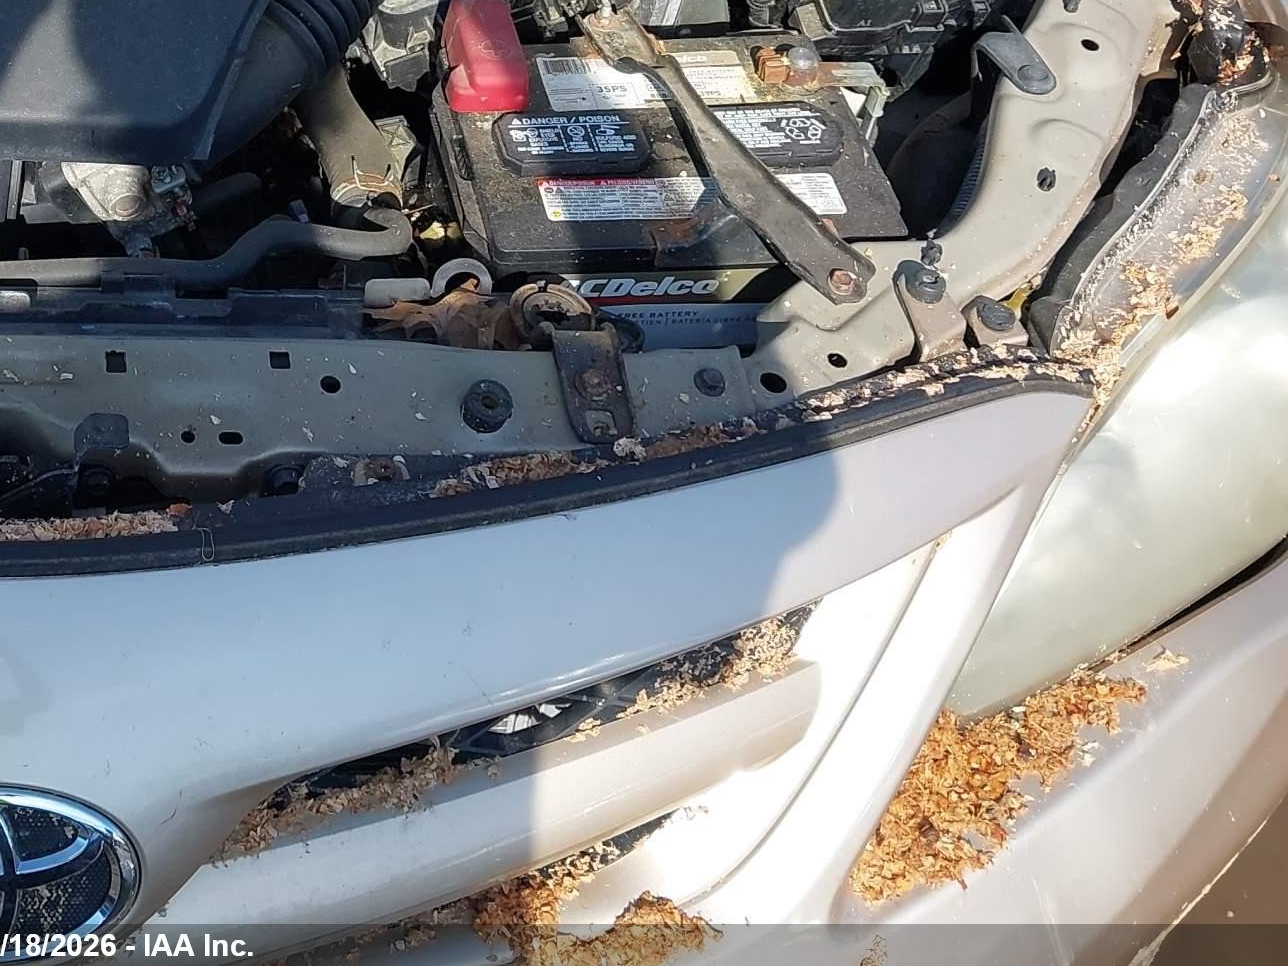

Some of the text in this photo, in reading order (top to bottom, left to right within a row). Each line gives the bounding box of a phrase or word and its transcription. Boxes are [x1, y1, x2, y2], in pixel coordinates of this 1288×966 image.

[596, 84, 628, 93] 35PS
[522, 116, 568, 125] DANGER
[578, 115, 620, 123] POISON
[581, 276, 720, 298] CDelco
[649, 310, 700, 319] BATTERY
